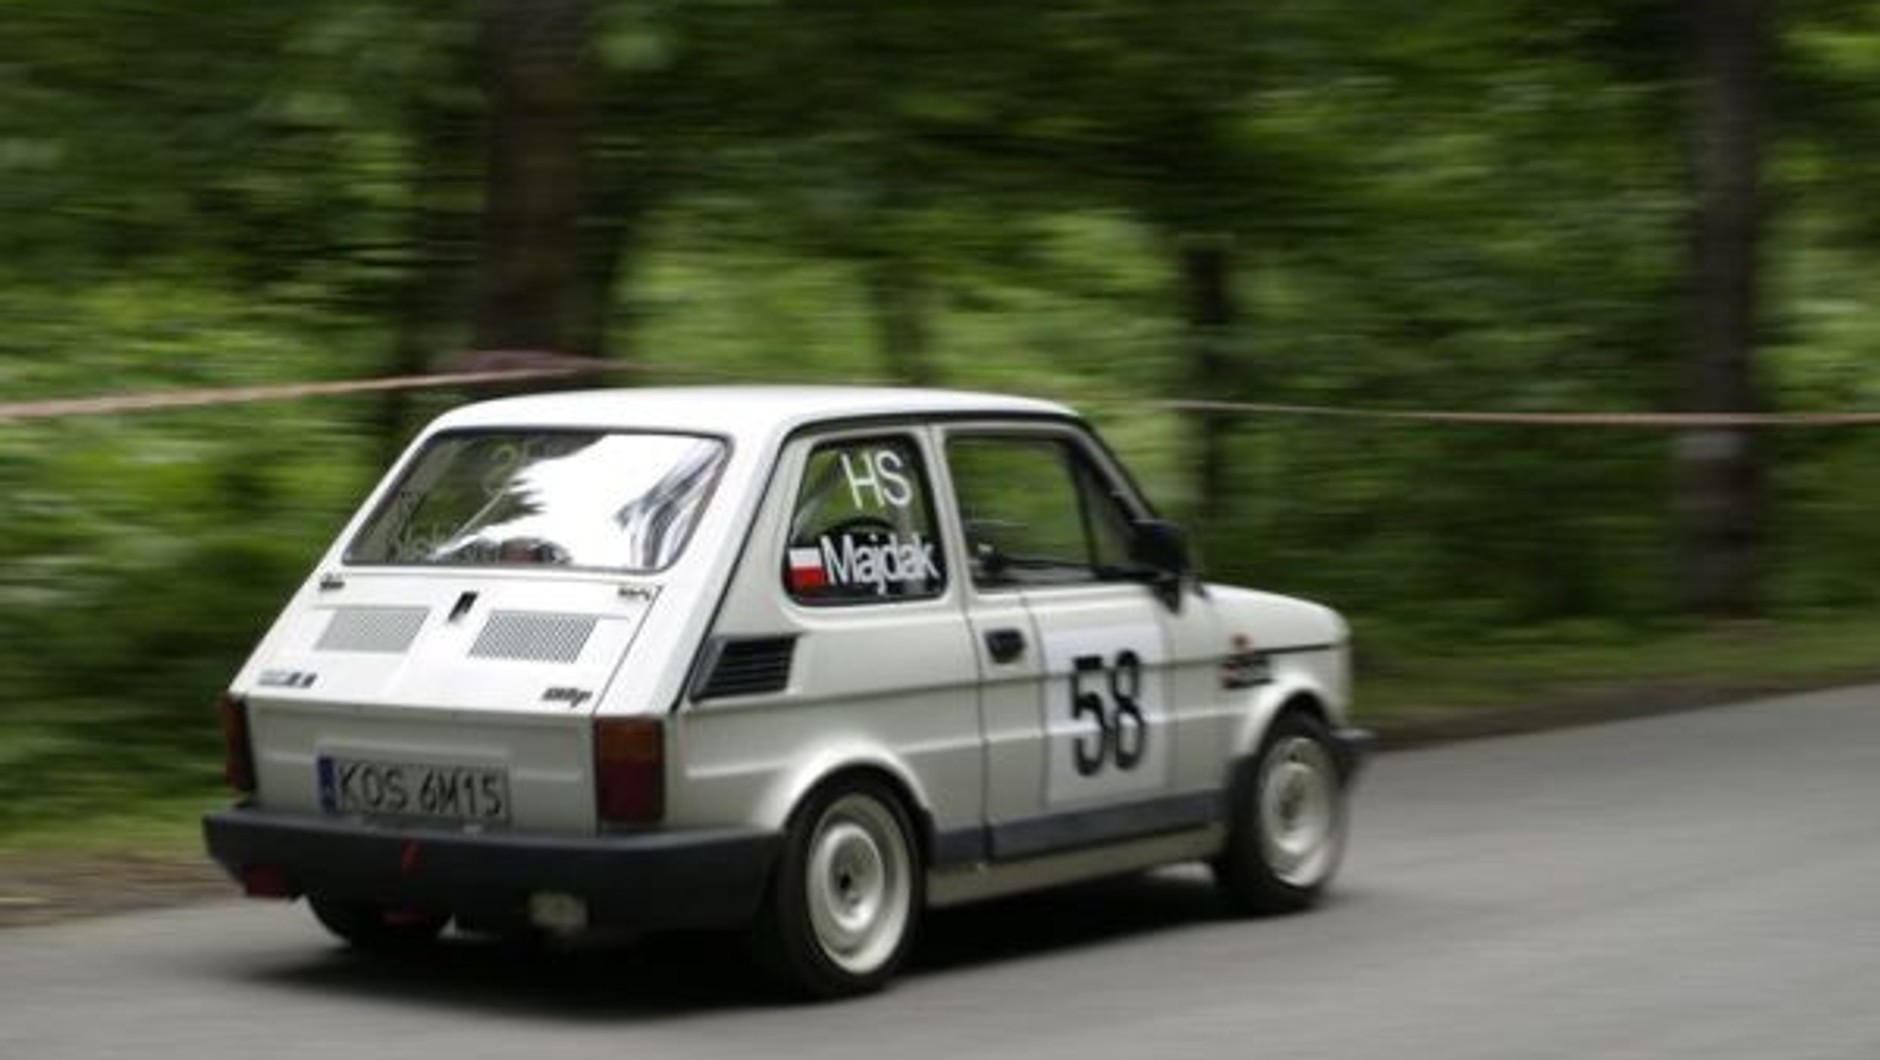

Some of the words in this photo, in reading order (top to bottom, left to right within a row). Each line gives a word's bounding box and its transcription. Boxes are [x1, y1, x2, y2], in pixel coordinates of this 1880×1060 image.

[841, 451, 913, 510] HS
[820, 532, 940, 595] Majdak
[1071, 649, 1147, 777] 58
[340, 760, 409, 811] KOS
[418, 766, 502, 817] 6M15
